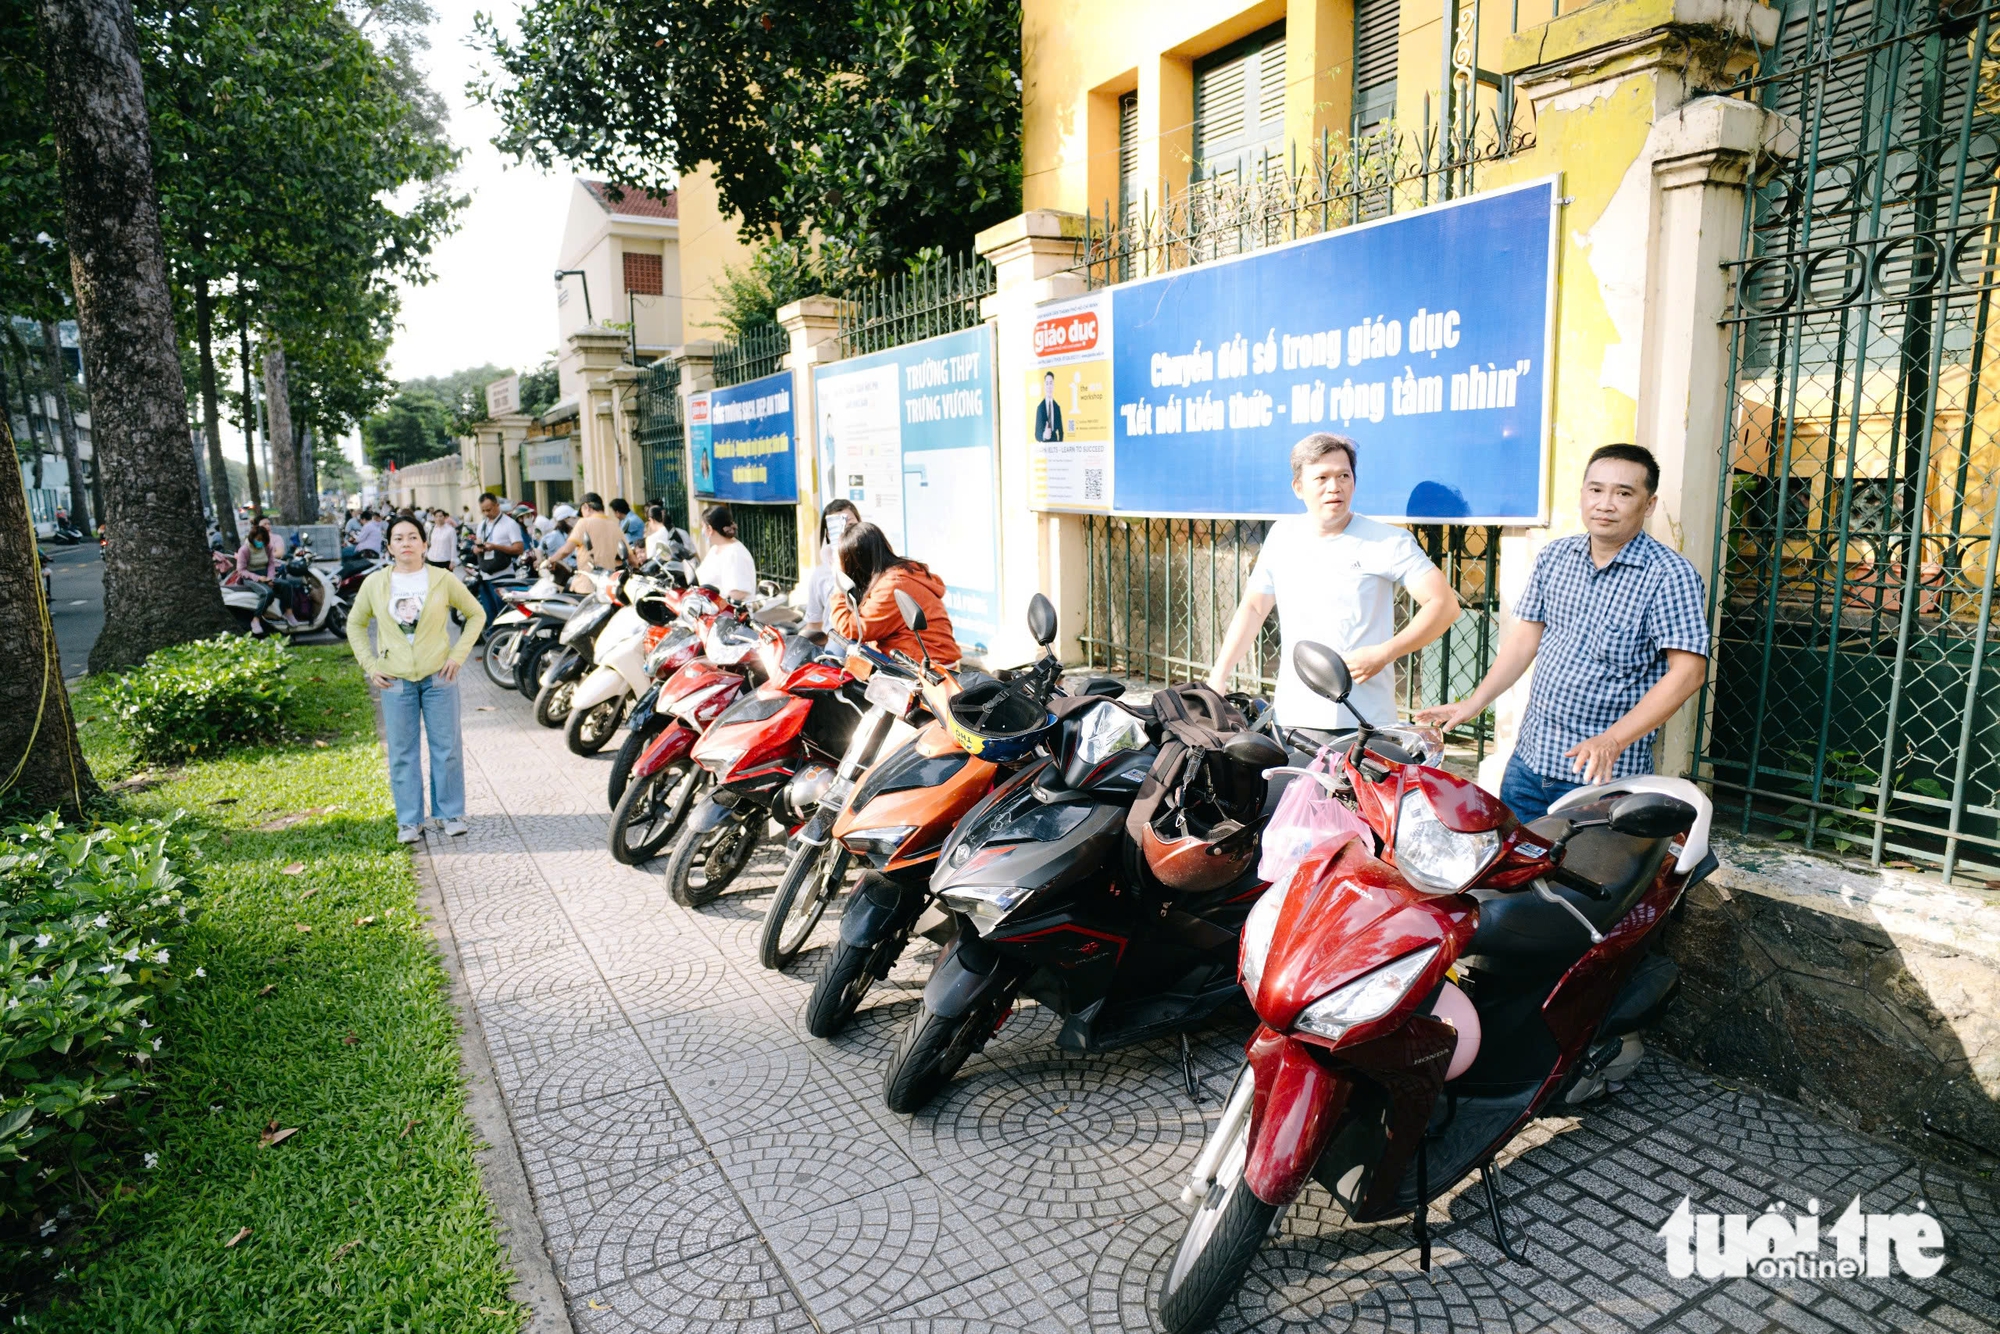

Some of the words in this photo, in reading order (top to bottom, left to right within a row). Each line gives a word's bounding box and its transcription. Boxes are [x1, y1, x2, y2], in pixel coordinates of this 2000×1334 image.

[1035, 323, 1067, 353] giáo
[1068, 319, 1096, 346] dục
[1151, 340, 1213, 388] Chuyển
[1217, 332, 1248, 380] đổi
[1252, 328, 1277, 375] số
[1282, 329, 1341, 370] trong
[1348, 315, 1402, 367] giáo
[1409, 308, 1461, 359] dục
[905, 357, 949, 391] TRƯỜNG
[949, 352, 981, 383] THPT
[941, 388, 983, 420] VƯƠNG
[1155, 394, 1182, 434] nối
[1186, 390, 1225, 432] kiến
[1229, 389, 1273, 429] thức
[1291, 379, 1326, 424] Mở
[1329, 378, 1385, 428] rộng
[1391, 365, 1443, 416] tầm
[1083, 445, 1105, 453] SUCCEED
[1413, 1048, 1450, 1065] HONDA
